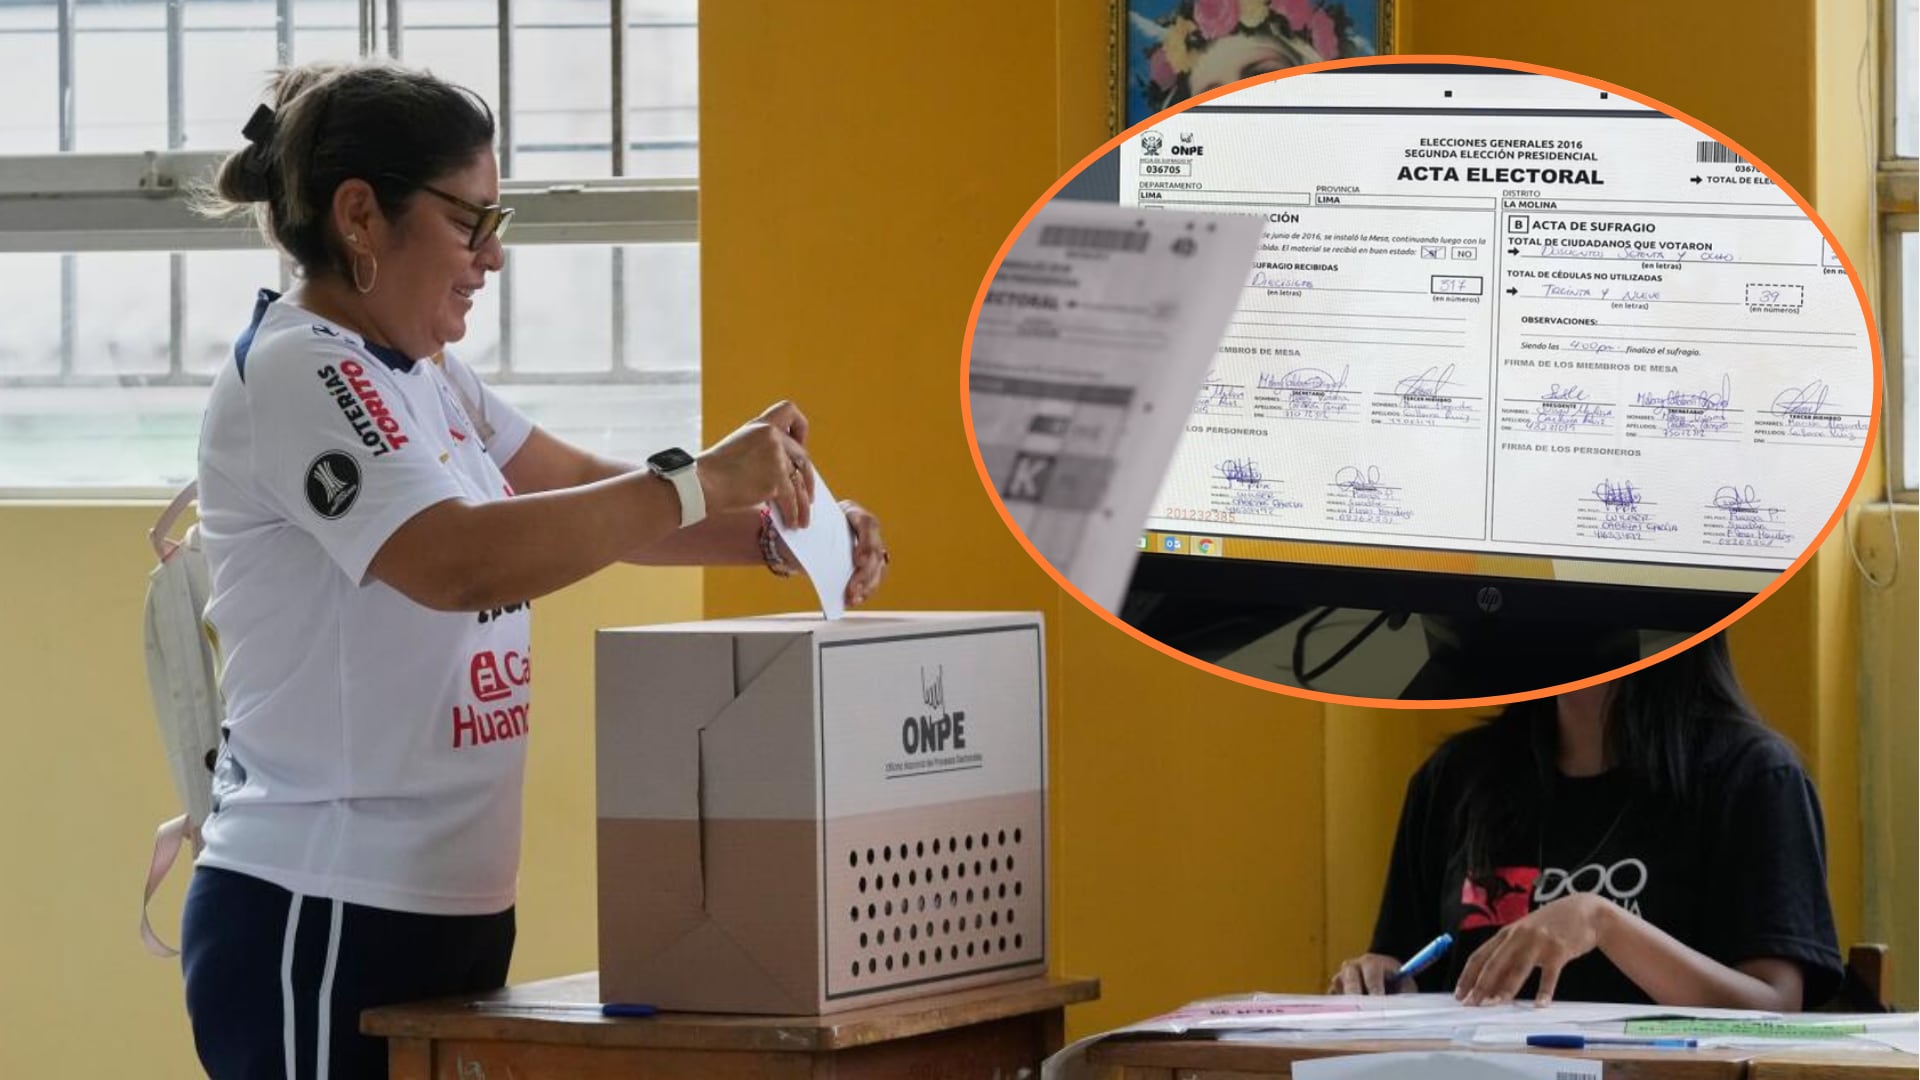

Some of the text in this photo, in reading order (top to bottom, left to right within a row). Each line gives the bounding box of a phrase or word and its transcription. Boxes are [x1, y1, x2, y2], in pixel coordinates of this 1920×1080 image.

[1420, 138, 1583, 149] ELECCIONES GENERALES 2016
[1171, 146, 1204, 156] ONPE
[1404, 149, 1598, 162] SEGUNDA ELECCIÓN PRESIDENCIAL
[1146, 165, 1181, 174] 036705
[1397, 166, 1605, 185] ACTA ELECTORAL
[1707, 176, 1737, 184] TOTAL
[1140, 181, 1202, 190] DEPARTAMENTO
[1316, 185, 1360, 193] PROVINCIA
[1502, 190, 1540, 198] DISTRITO
[1317, 196, 1340, 204] LIMA
[1518, 201, 1558, 209] MOLINA
[1515, 220, 1523, 229] B
[1532, 220, 1656, 233] ACTA DE SUFRAGIO
[1270, 232, 1290, 241] junio
[1334, 232, 1359, 241] instaló
[1392, 236, 1439, 244] continuando
[1440, 237, 1460, 246] luego
[1508, 237, 1713, 250] TOTAL DE CIUDADANOS QUE VOTARON
[1389, 248, 1416, 256] estado:
[1458, 250, 1472, 258] NO
[1294, 263, 1338, 271] RECIBIDAS
[1655, 262, 1682, 270] letras)
[1507, 270, 1536, 278] TOTAL
[1552, 270, 1592, 280] CÉDULAS
[1610, 274, 1662, 282] UTILIZADAS
[1267, 289, 1302, 298] (en letras)
[1445, 296, 1480, 304] números)
[1611, 302, 1649, 310] (en letras)
[1750, 306, 1800, 314] (en números)
[1521, 316, 1598, 326] OBSERVACIONES:
[1521, 342, 1547, 350] Siendo
[1260, 347, 1273, 355] DE
[1274, 348, 1301, 356] MESA
[1625, 346, 1656, 354] finalizó
[1667, 348, 1701, 358] sufragio.
[1504, 359, 1535, 367] FIRMA
[1538, 360, 1552, 368] DE
[1576, 361, 1630, 371] MIEMBROS
[1633, 362, 1647, 372] DE
[1650, 364, 1678, 373] MESA
[340, 359, 409, 451] TORITO
[1206, 426, 1268, 437] PERSONEROS
[1502, 443, 1641, 457] FIRMA DE LOS PERSONEROS
[452, 703, 530, 749] Huan
[902, 711, 966, 755] ONPE
